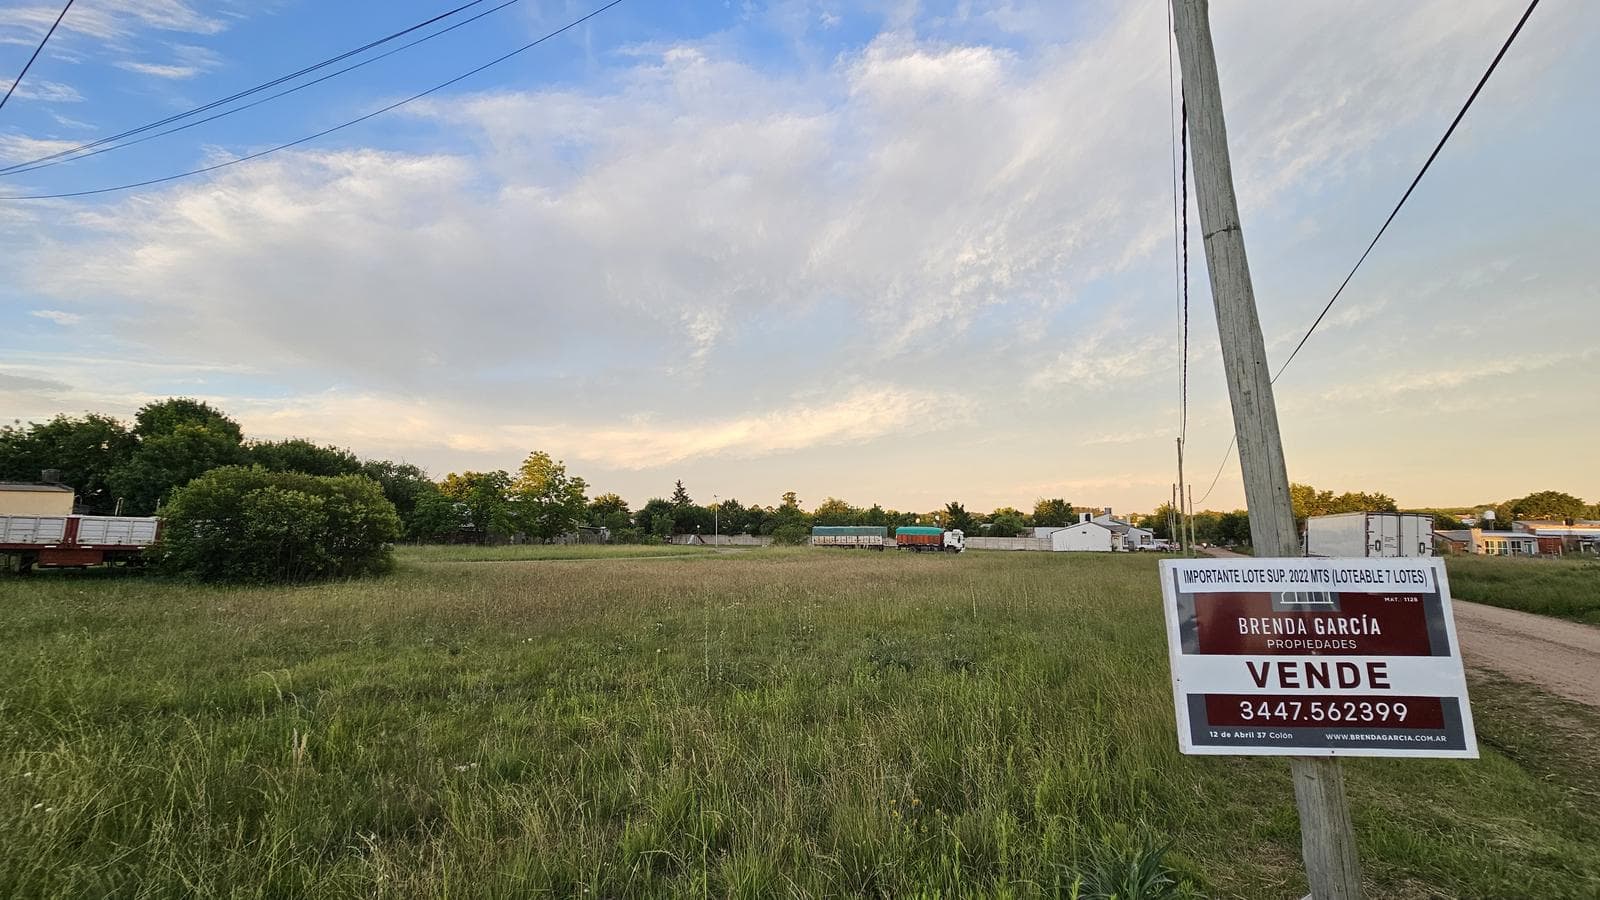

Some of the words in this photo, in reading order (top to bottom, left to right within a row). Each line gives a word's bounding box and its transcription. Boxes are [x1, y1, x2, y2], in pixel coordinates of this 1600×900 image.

[1184, 568, 1241, 584] IMPORTANTE
[1242, 568, 1266, 584] LOTE
[1267, 568, 1288, 584] SUP.
[1289, 568, 1309, 584] 2022
[1311, 568, 1331, 584] MTS
[1332, 568, 1384, 586] (LOTEABLE
[1385, 569, 1392, 584] 7
[1394, 568, 1428, 587] LOTES)
[1238, 617, 1308, 635] BRENDA
[1314, 614, 1382, 635] GARCÍA
[1267, 639, 1357, 649] PROPIEDADES
[1246, 661, 1391, 689] VENDE
[1239, 701, 1408, 722] 3447.562399
[1234, 731, 1255, 739] Abril
[1269, 731, 1293, 740] Colón
[1326, 733, 1447, 742] WWW.BRENDAGARCIA.COM.AR
